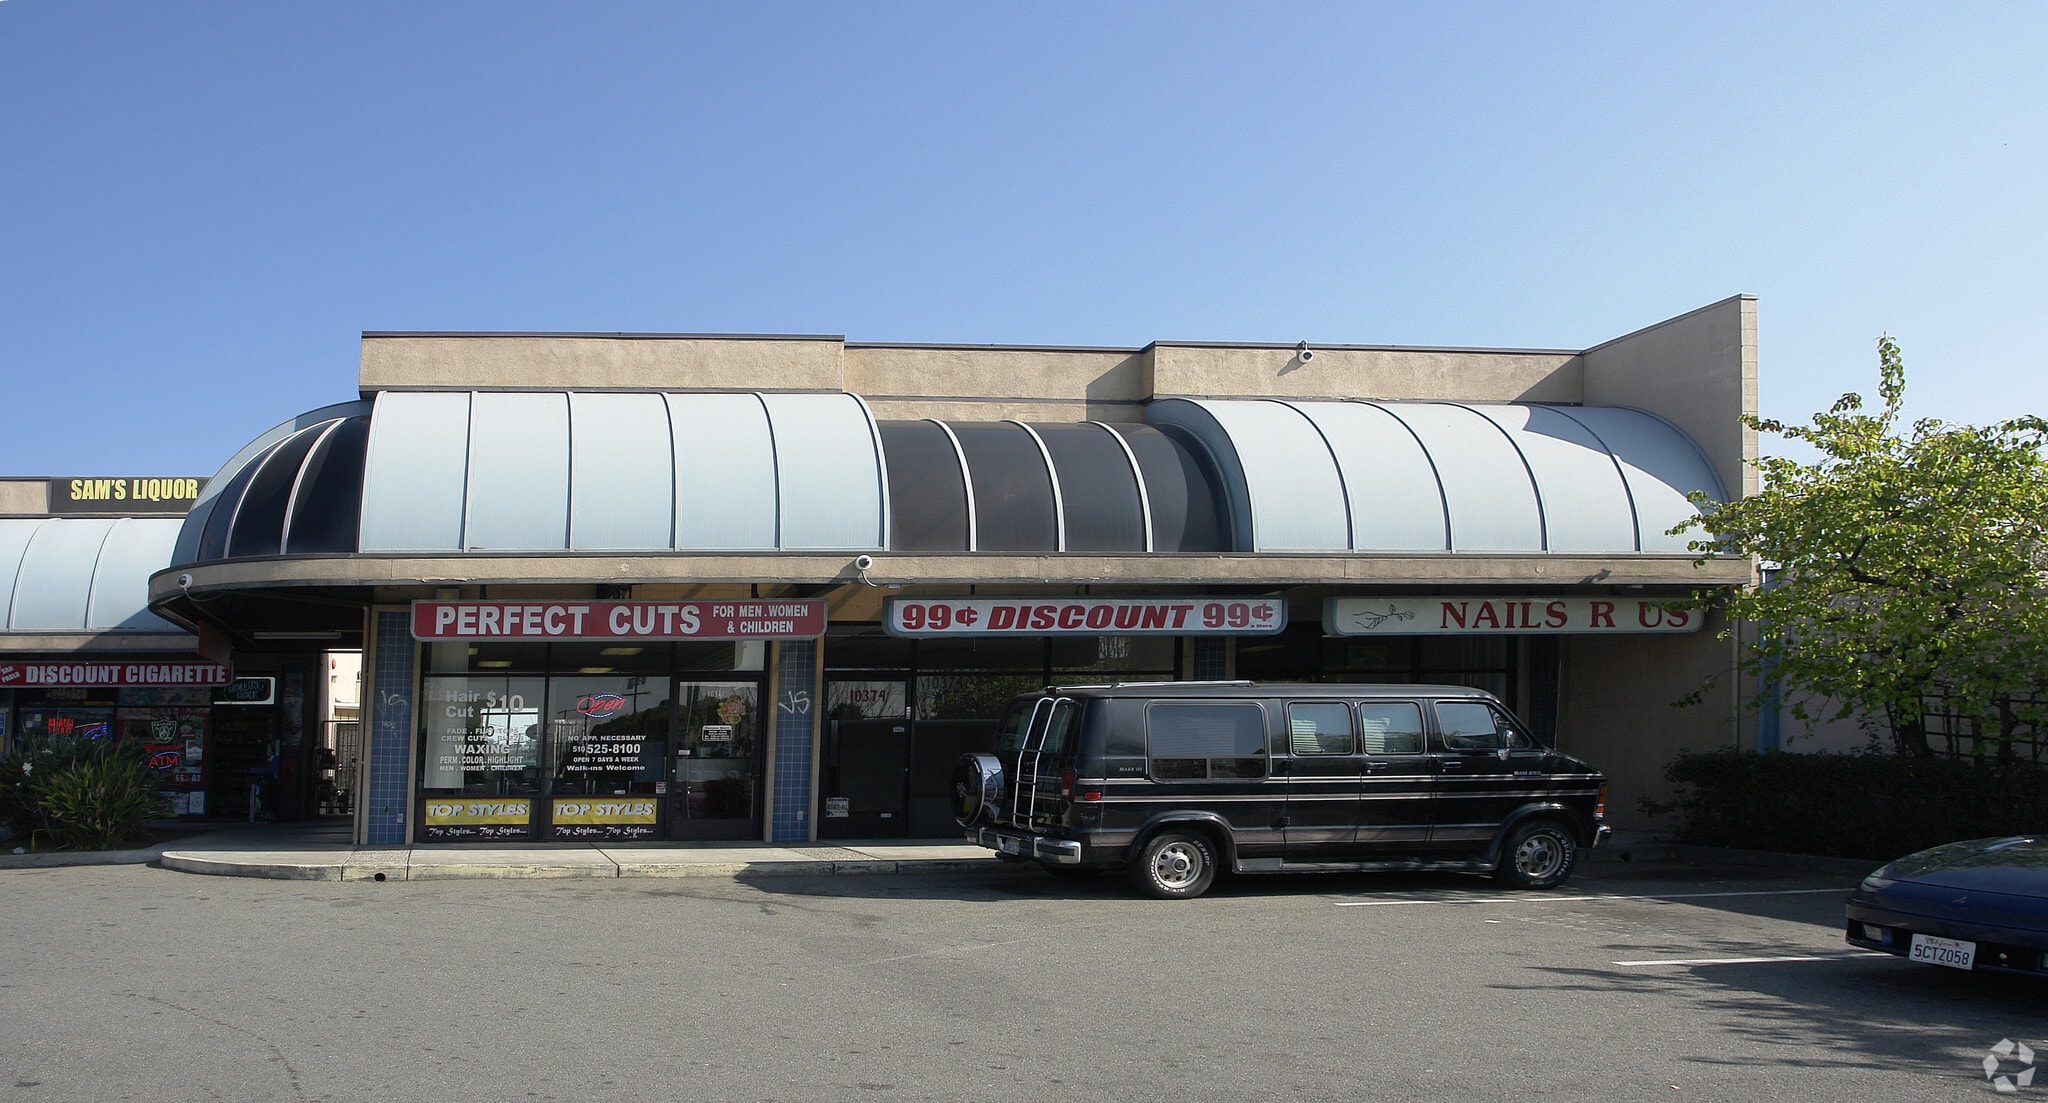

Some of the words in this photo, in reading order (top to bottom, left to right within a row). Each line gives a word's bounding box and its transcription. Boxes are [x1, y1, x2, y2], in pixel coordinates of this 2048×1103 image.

[71, 479, 127, 501] SAM'S
[132, 479, 198, 502] LIQUOR
[713, 605, 735, 618] FOR
[902, 603, 978, 630] 99¢
[986, 604, 1195, 630] DISCOUNT
[1202, 602, 1274, 629] 99¢
[1439, 601, 1569, 629] NAILS
[1589, 601, 1616, 628] R
[1638, 600, 1690, 628] US
[434, 605, 590, 635] PERFECT
[608, 604, 701, 635] CUTS
[727, 621, 735, 634] &
[740, 620, 794, 633] CHILDREN
[25, 665, 121, 684] DISCOUNT
[125, 665, 226, 683] CIGARETTE
[446, 690, 481, 703] Hair
[486, 690, 525, 713] $10
[576, 697, 627, 715] Open
[445, 705, 475, 718] Cut
[454, 744, 511, 754] WAXING
[587, 744, 641, 754] 525-8100
[149, 756, 179, 767] ATM
[487, 756, 523, 764] HIGHLIGHT
[427, 803, 465, 817] TOP
[467, 803, 528, 817] STYLES
[554, 803, 592, 817] TOP
[594, 803, 655, 817] STYLES
[428, 827, 445, 836] Top
[479, 827, 494, 836] Top
[556, 827, 572, 836] Top
[606, 827, 622, 836] Top
[1914, 944, 1970, 966] 5CTZ058
